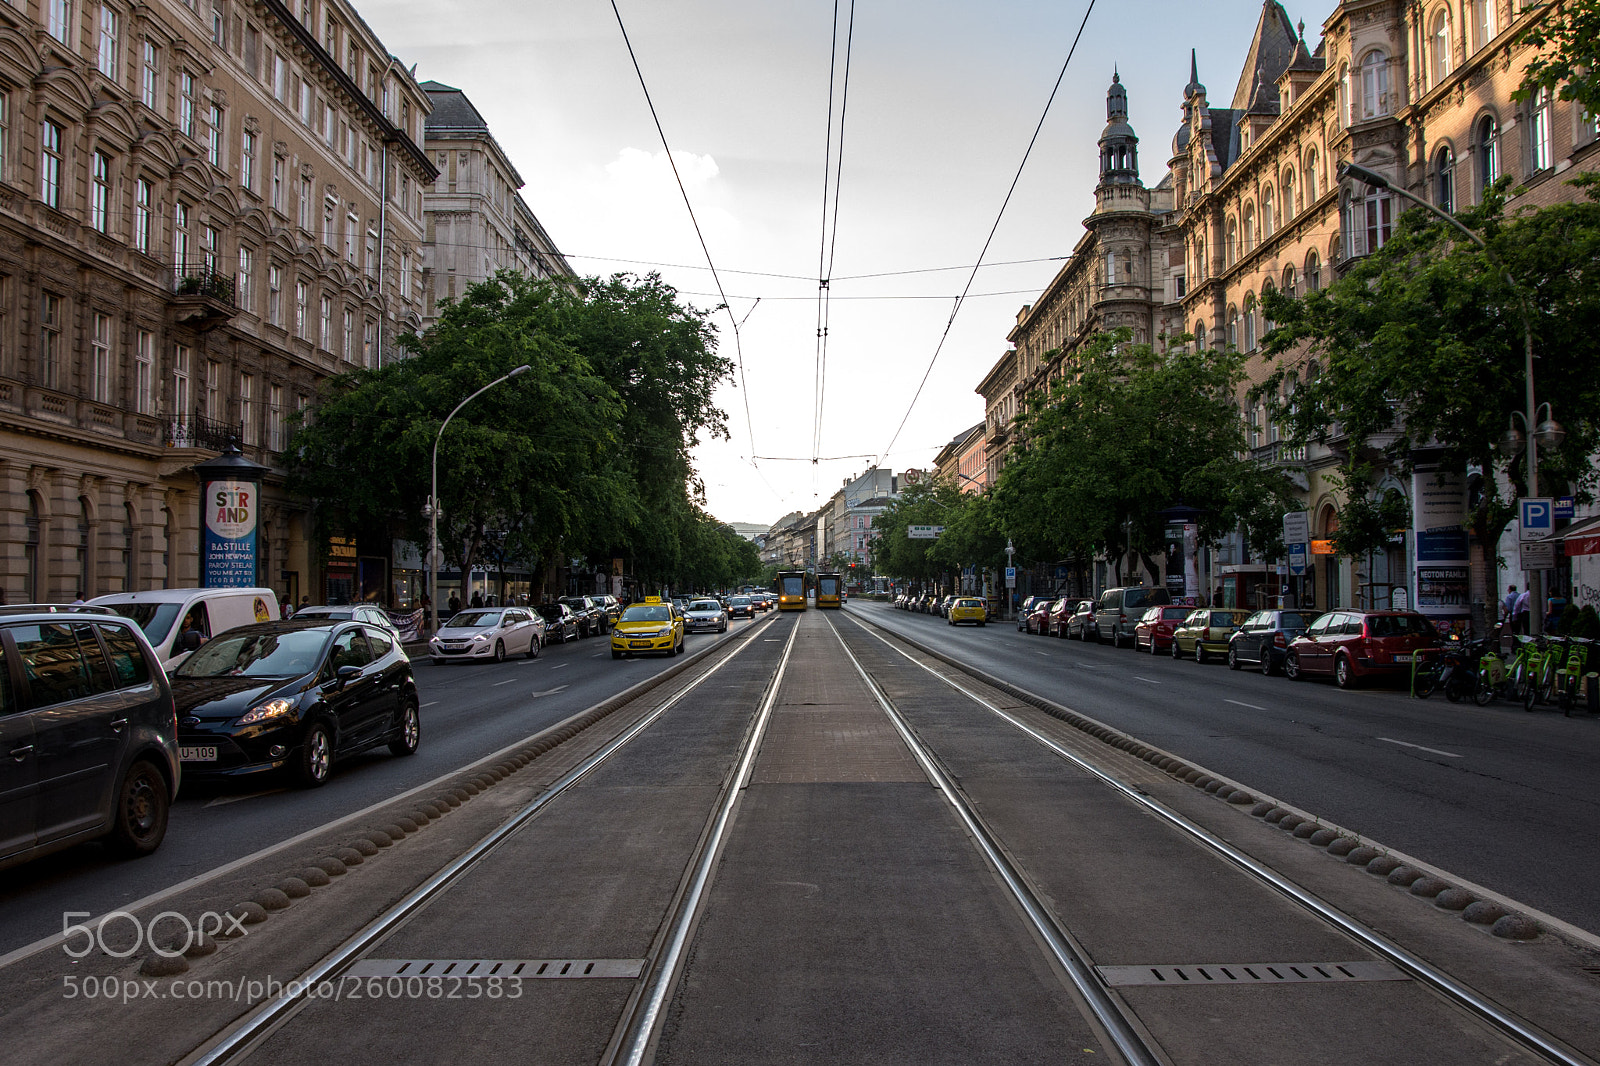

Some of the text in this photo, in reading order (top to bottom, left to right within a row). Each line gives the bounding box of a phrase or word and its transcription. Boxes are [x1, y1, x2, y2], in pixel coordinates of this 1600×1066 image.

[216, 492, 249, 507] STR
[216, 508, 249, 523] AND
[1527, 504, 1545, 526] P
[211, 542, 251, 551] BASTILLE
[1293, 544, 1301, 553] P
[1420, 570, 1445, 578] NEOTON
[179, 748, 214, 758] U-109
